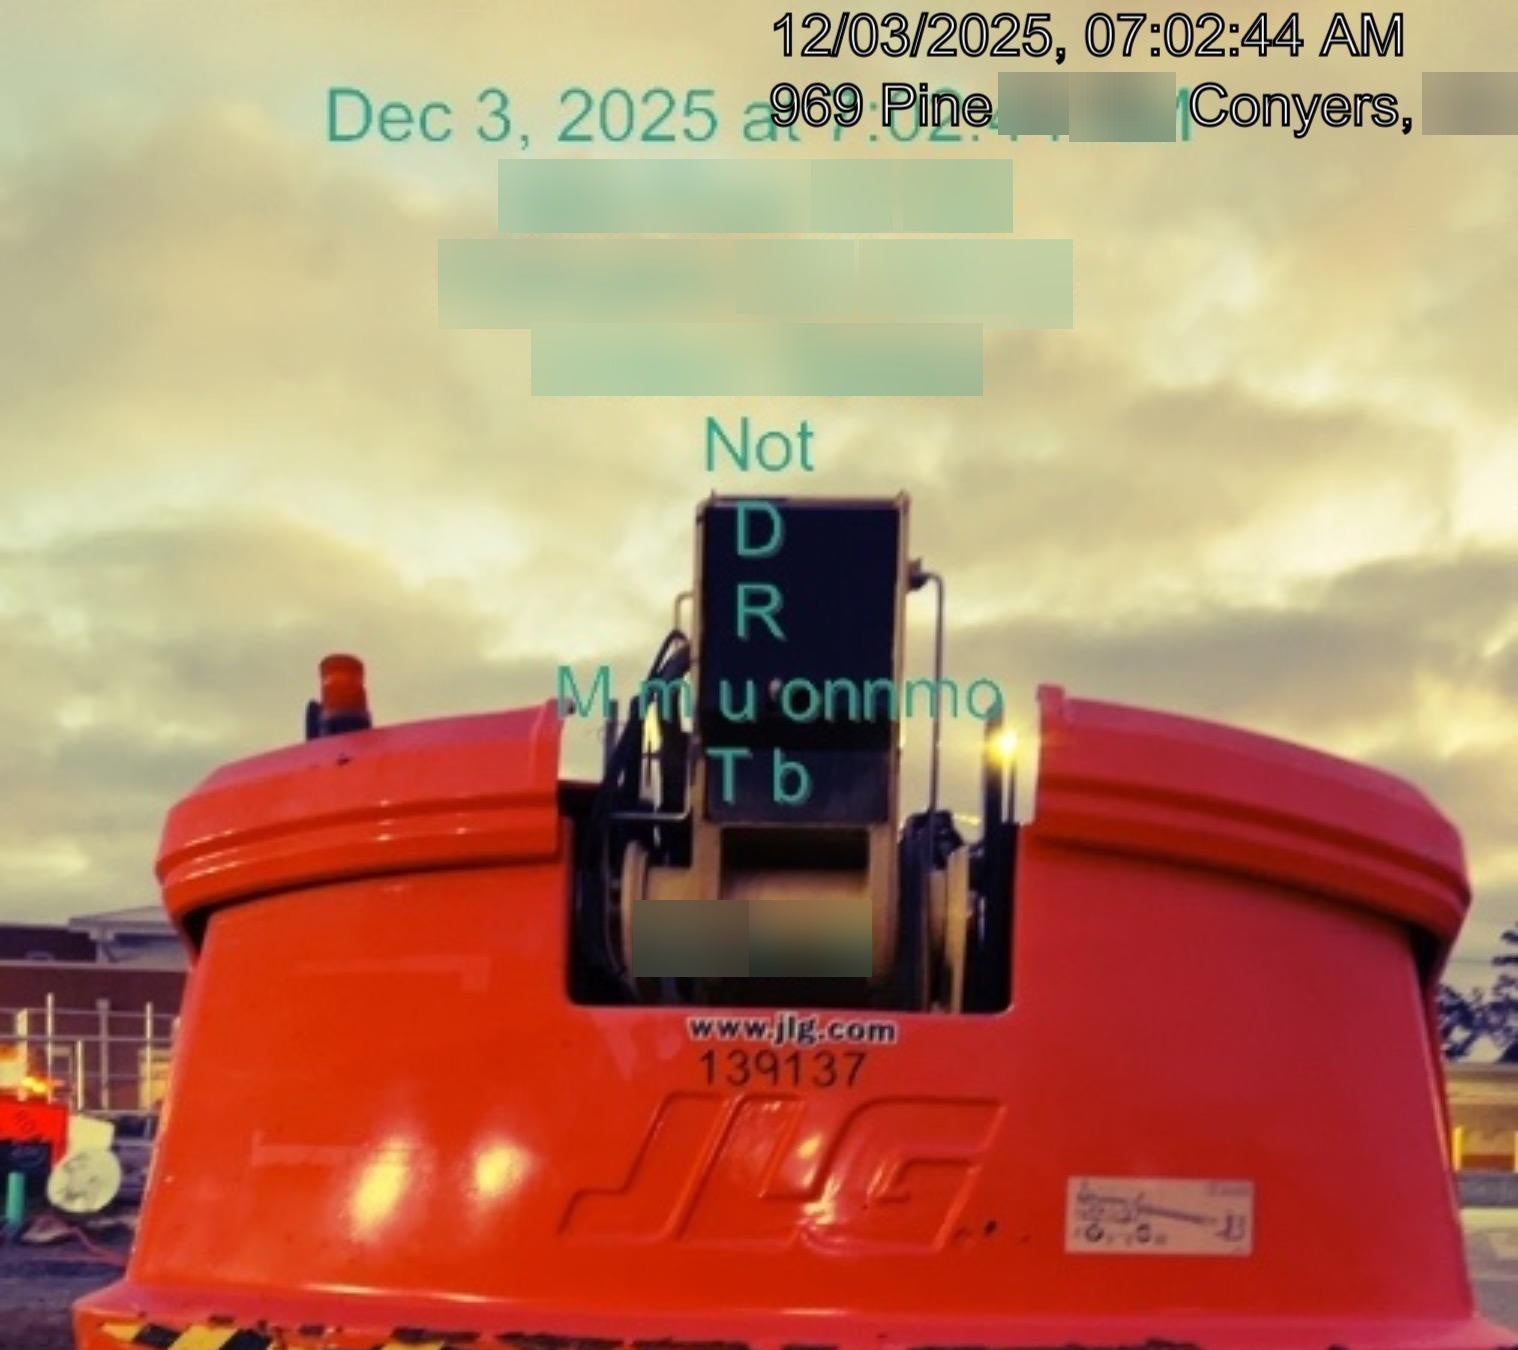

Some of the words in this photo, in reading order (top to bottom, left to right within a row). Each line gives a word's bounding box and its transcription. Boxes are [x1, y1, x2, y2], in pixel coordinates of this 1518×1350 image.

[688, 1012, 898, 1046] www.jlg.com
[700, 1048, 867, 1088] 139137
[557, 1092, 1007, 1256] JLG
